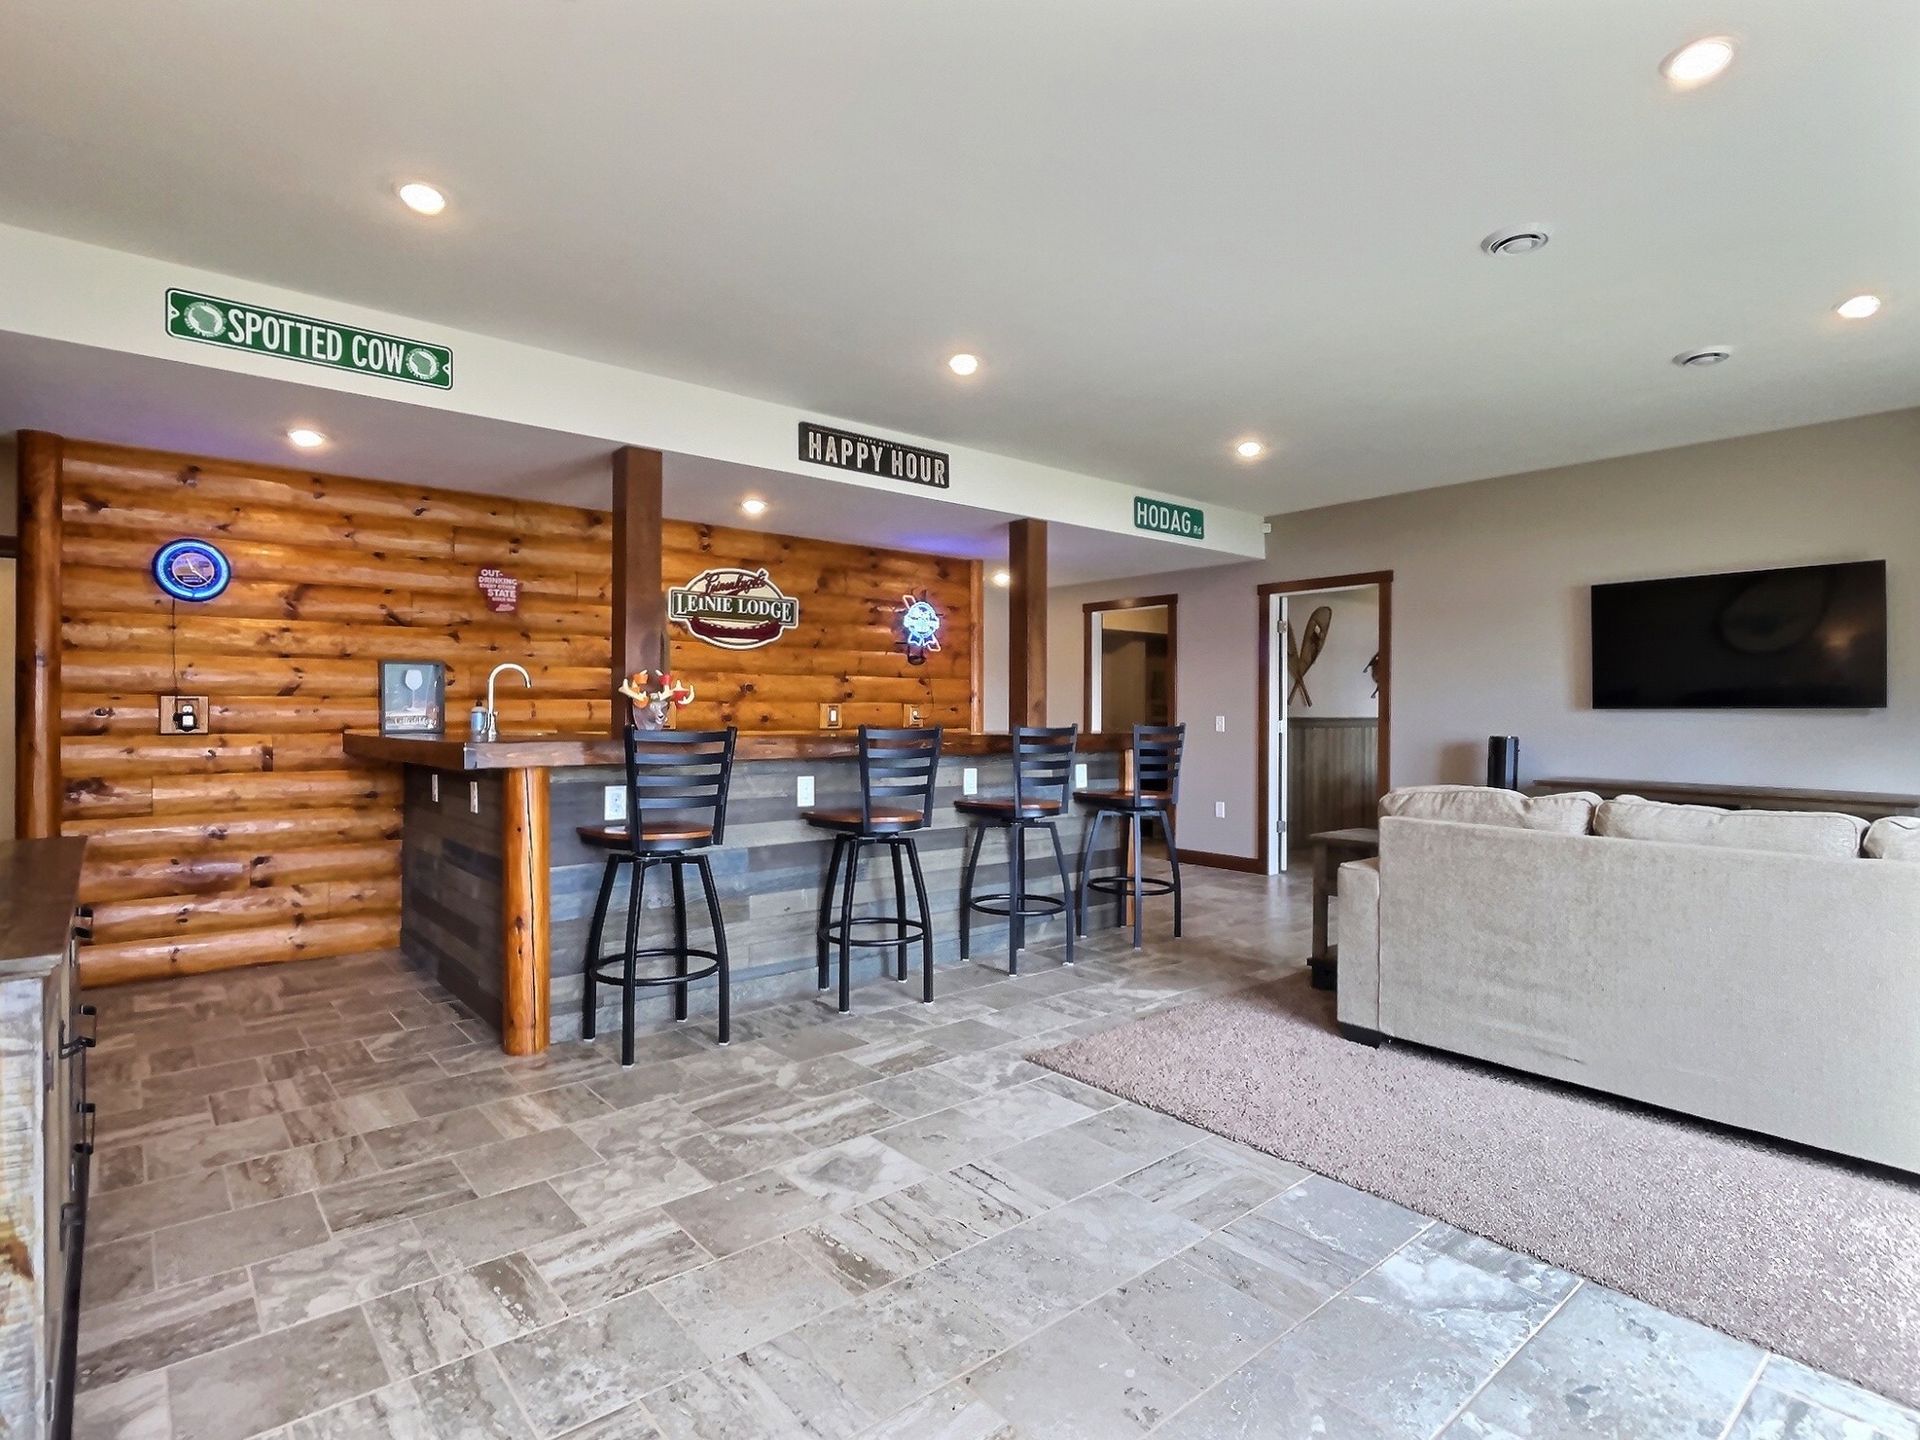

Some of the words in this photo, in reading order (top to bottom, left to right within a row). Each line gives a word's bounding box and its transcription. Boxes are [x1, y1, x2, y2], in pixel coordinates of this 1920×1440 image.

[227, 308, 343, 362] SPOTTED
[351, 334, 405, 374] COW
[808, 431, 883, 472] HAPPY
[891, 449, 945, 485] HOUR
[1137, 502, 1191, 533] HODAG
[478, 576, 518, 585] DRINKING
[480, 569, 503, 577] OUT-
[487, 589, 516, 599] STATE
[676, 592, 733, 615] LEINIE
[738, 598, 792, 622] LODGE
